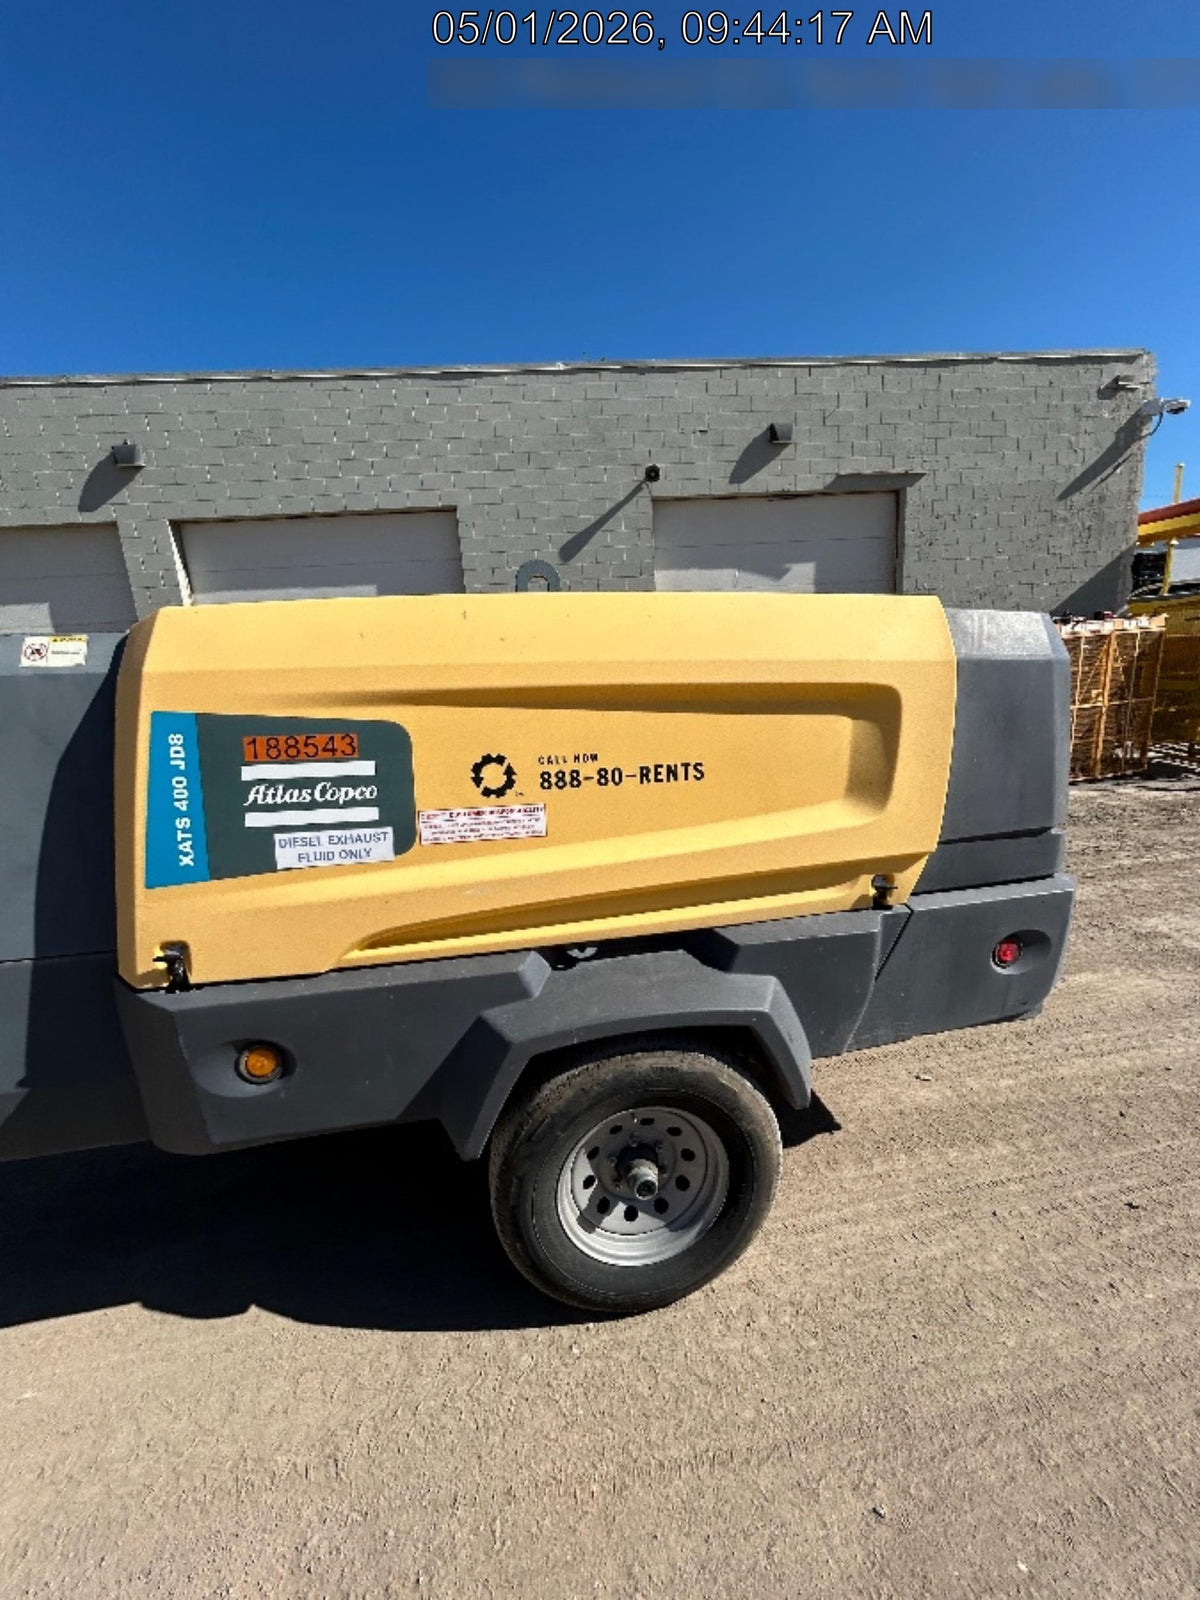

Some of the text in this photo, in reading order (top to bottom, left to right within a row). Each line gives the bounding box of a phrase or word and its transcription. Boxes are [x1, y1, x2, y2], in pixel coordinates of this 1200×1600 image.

[246, 733, 357, 760] 188543
[537, 753, 599, 766] CALL NOW
[539, 762, 705, 790] 888-80-RENTS
[168, 733, 194, 866] XATS 400 JD8
[243, 781, 378, 806] Atlas Copco
[278, 831, 389, 849] DIESEL EXHAUST
[297, 847, 373, 863] FLUID ONLY
